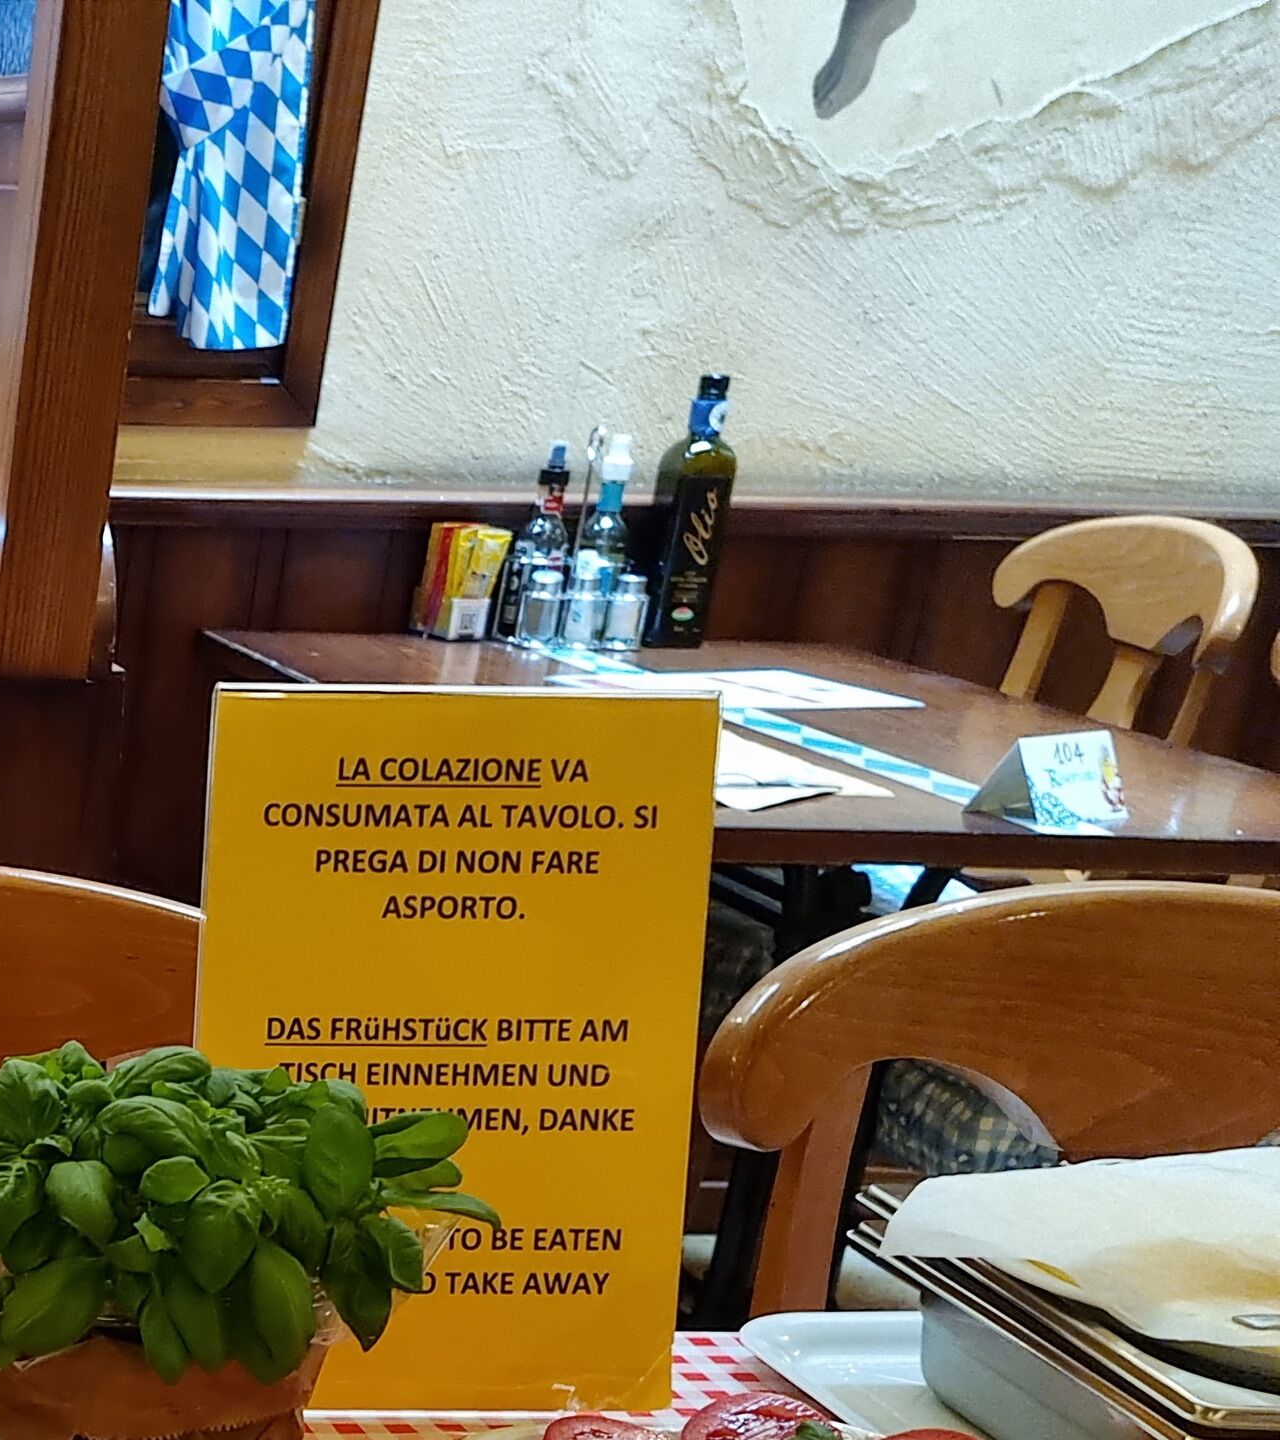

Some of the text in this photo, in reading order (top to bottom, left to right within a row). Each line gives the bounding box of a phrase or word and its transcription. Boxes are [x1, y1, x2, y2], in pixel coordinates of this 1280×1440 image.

[1054, 742, 1085, 765] 104
[338, 757, 589, 783] LA COLAZIONE VA
[263, 803, 658, 829] CONSUMATA AL TAVOLO. SI
[315, 849, 600, 875] PREGA DI NON FARE
[381, 895, 525, 920] ASPORTO.
[267, 1017, 321, 1041] DAS
[496, 1018, 572, 1042] BITTE
[579, 1019, 629, 1042] AM
[279, 1062, 610, 1087] TISCH EINNEHMEN UND
[539, 1108, 635, 1132] DANKE
[448, 1227, 622, 1252] TO BE EATEN
[444, 1272, 515, 1295] TAKE
[521, 1272, 610, 1295] AWAY
